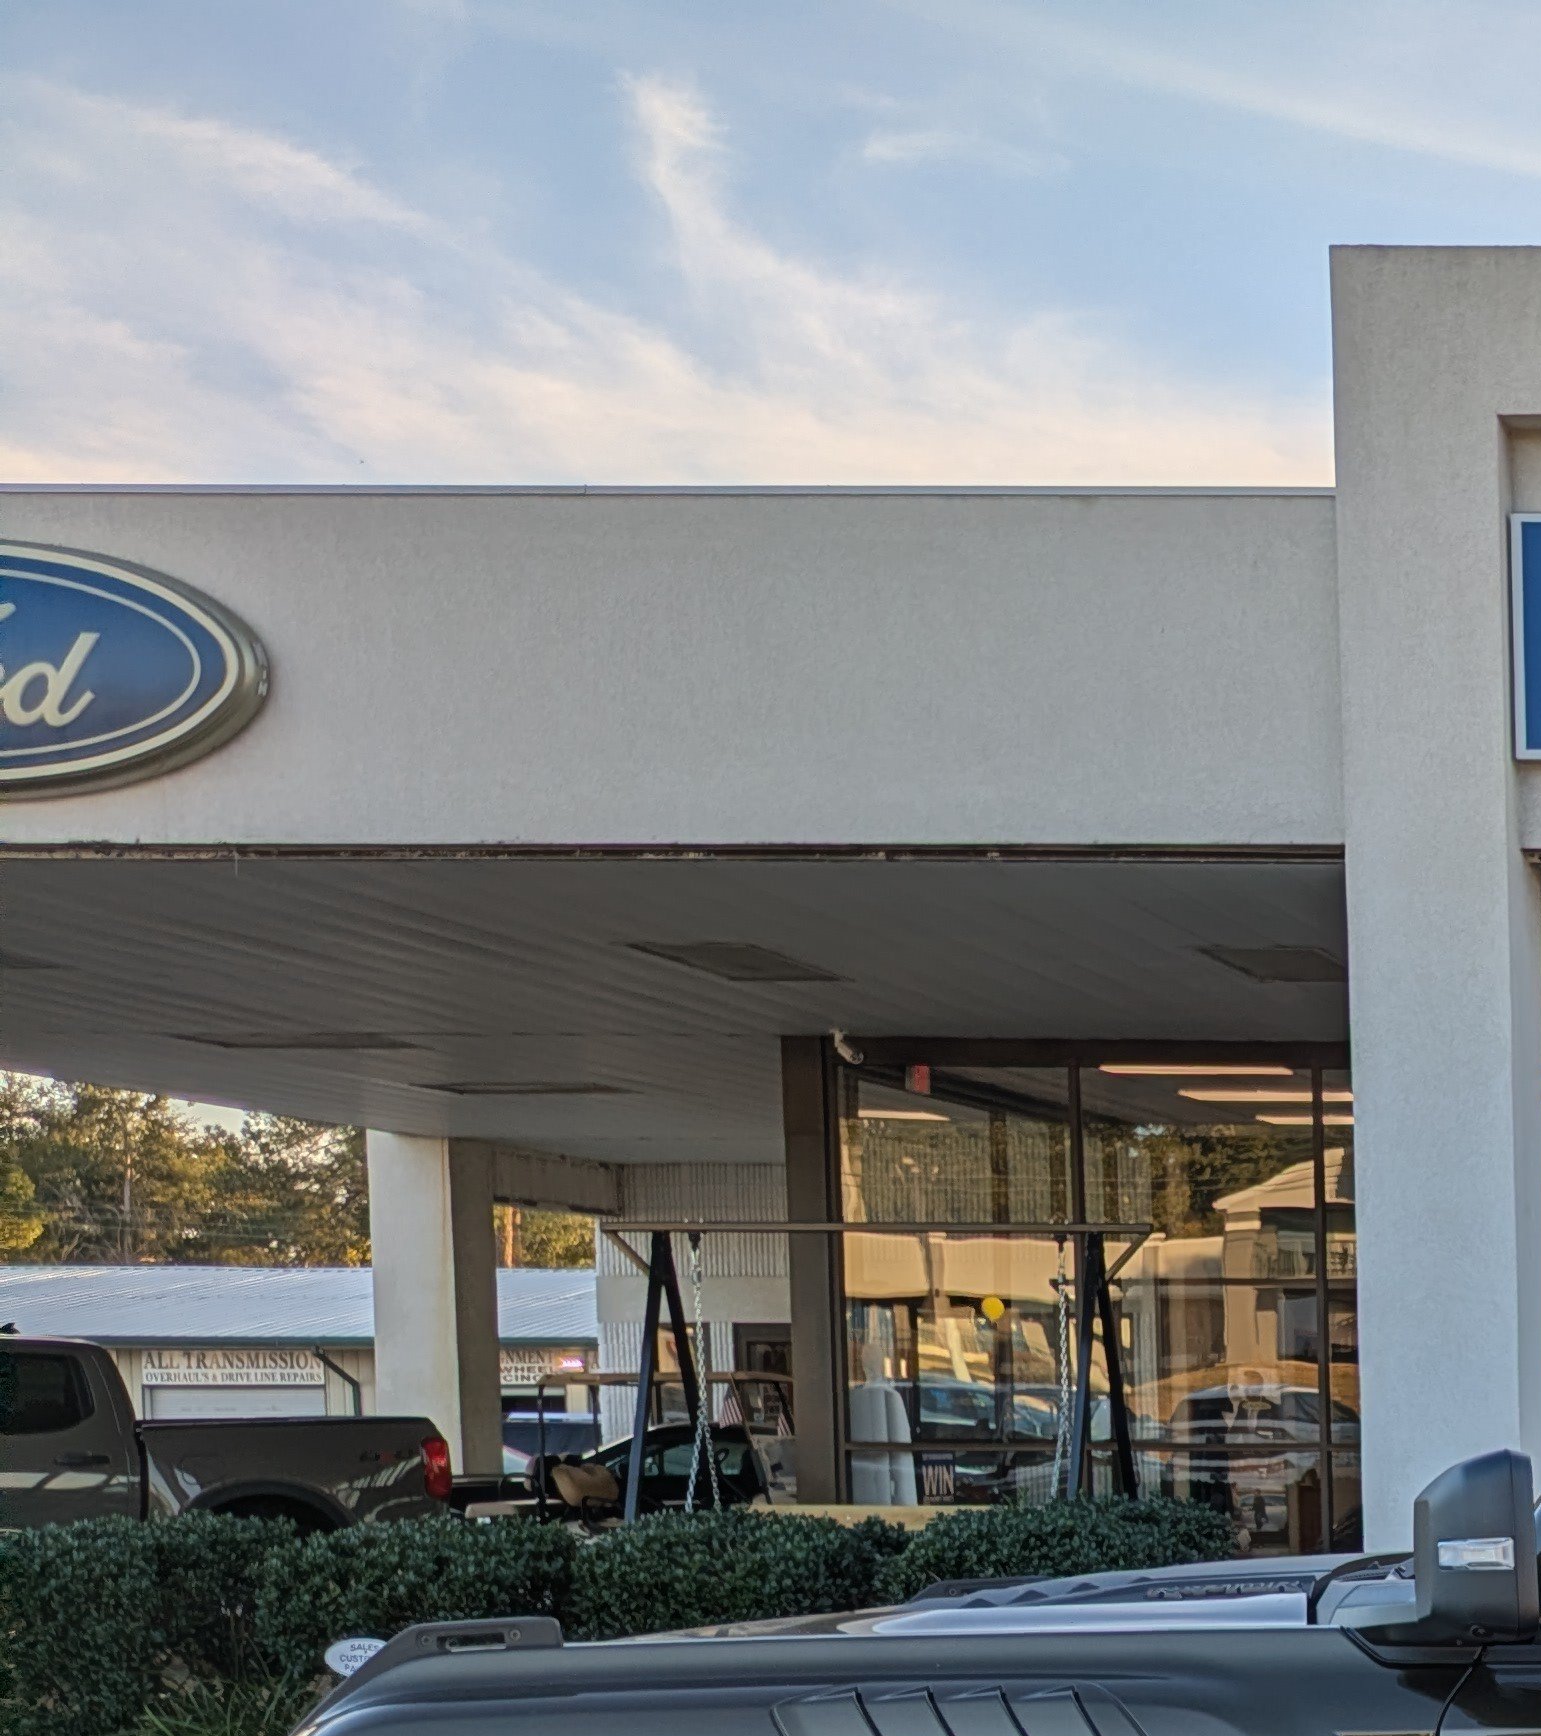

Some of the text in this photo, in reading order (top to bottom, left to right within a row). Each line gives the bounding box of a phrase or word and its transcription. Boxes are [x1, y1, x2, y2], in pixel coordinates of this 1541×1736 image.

[144, 1351, 322, 1369] ALL TRANSMISSION
[145, 1372, 323, 1383] OVERHAUL'S & DRIVE LINE REPAIRS
[922, 1464, 954, 1496] WIN
